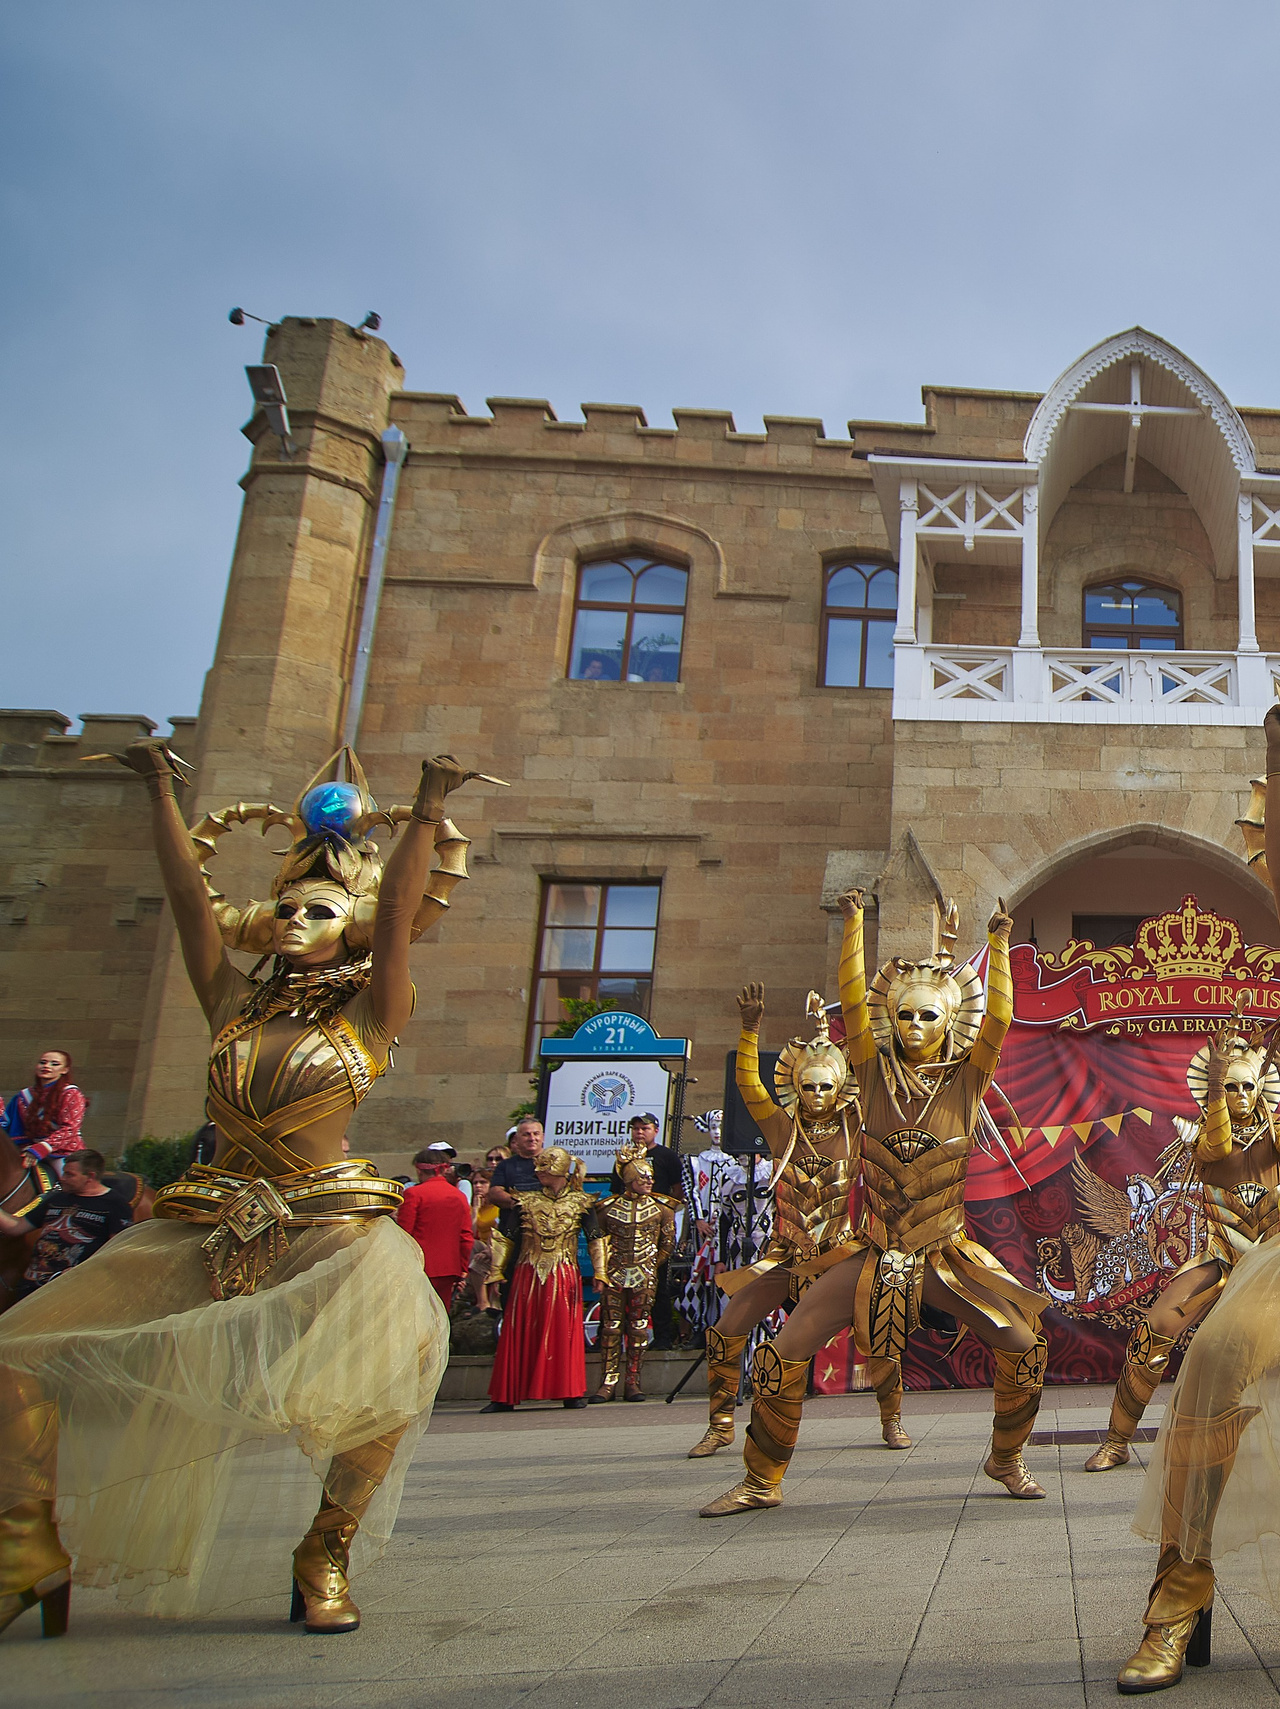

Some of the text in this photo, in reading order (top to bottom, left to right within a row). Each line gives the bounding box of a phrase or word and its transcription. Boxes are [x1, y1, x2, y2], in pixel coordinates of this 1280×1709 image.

[1098, 985, 1181, 1012] ROYAL
[584, 1014, 647, 1035] КУРОРТНЫЙ
[1127, 1018, 1253, 1037] by GIA ERADE
[604, 1027, 625, 1044] 21
[553, 1136, 624, 1148] интерактивный
[1107, 1280, 1152, 1309] ROYAL
